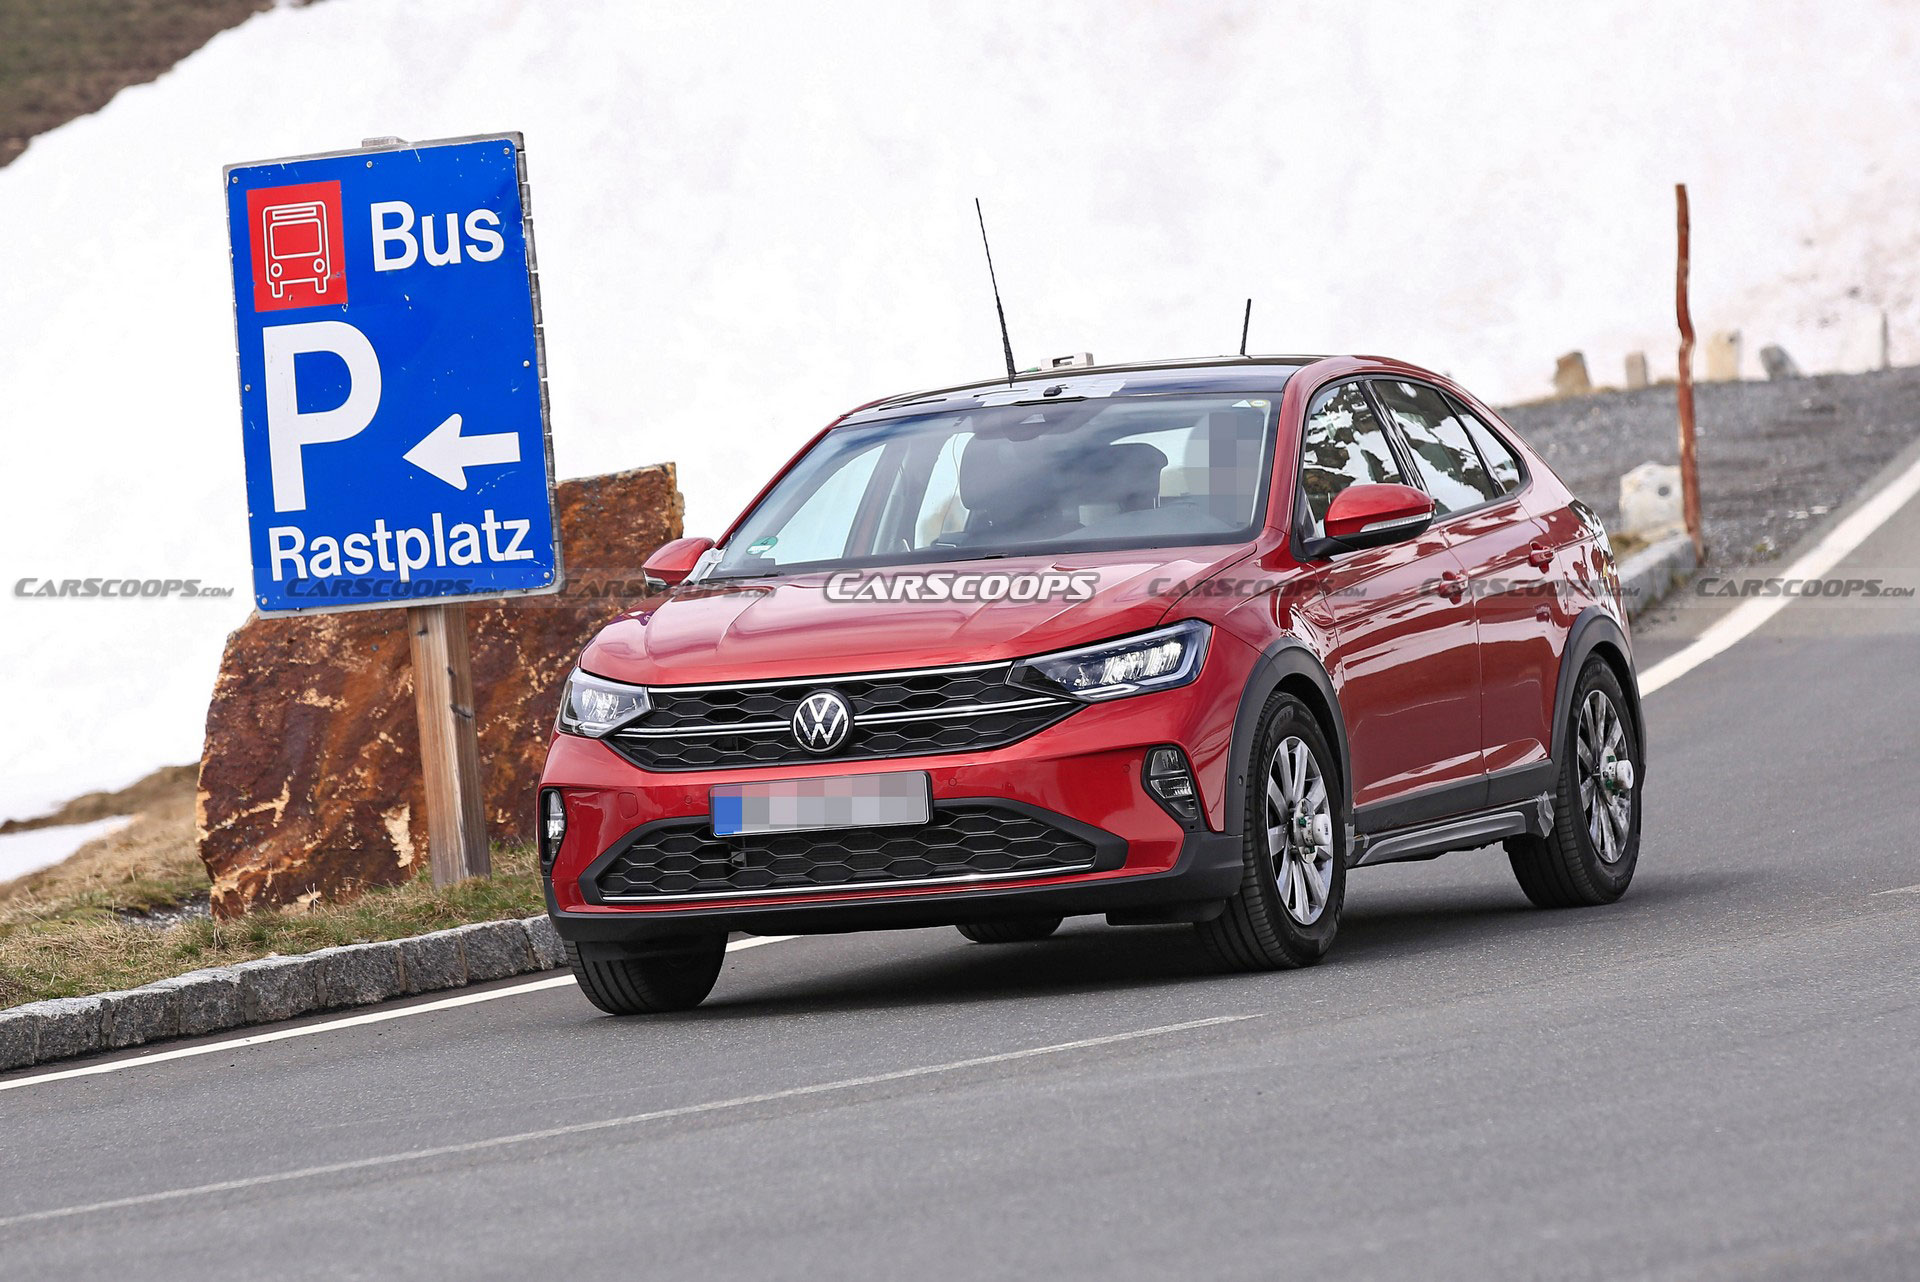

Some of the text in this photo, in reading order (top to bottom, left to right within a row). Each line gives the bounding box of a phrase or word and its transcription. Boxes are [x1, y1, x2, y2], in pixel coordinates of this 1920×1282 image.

[370, 200, 505, 272] Bus
[263, 320, 382, 513] P
[268, 509, 535, 583] Rastplatz
